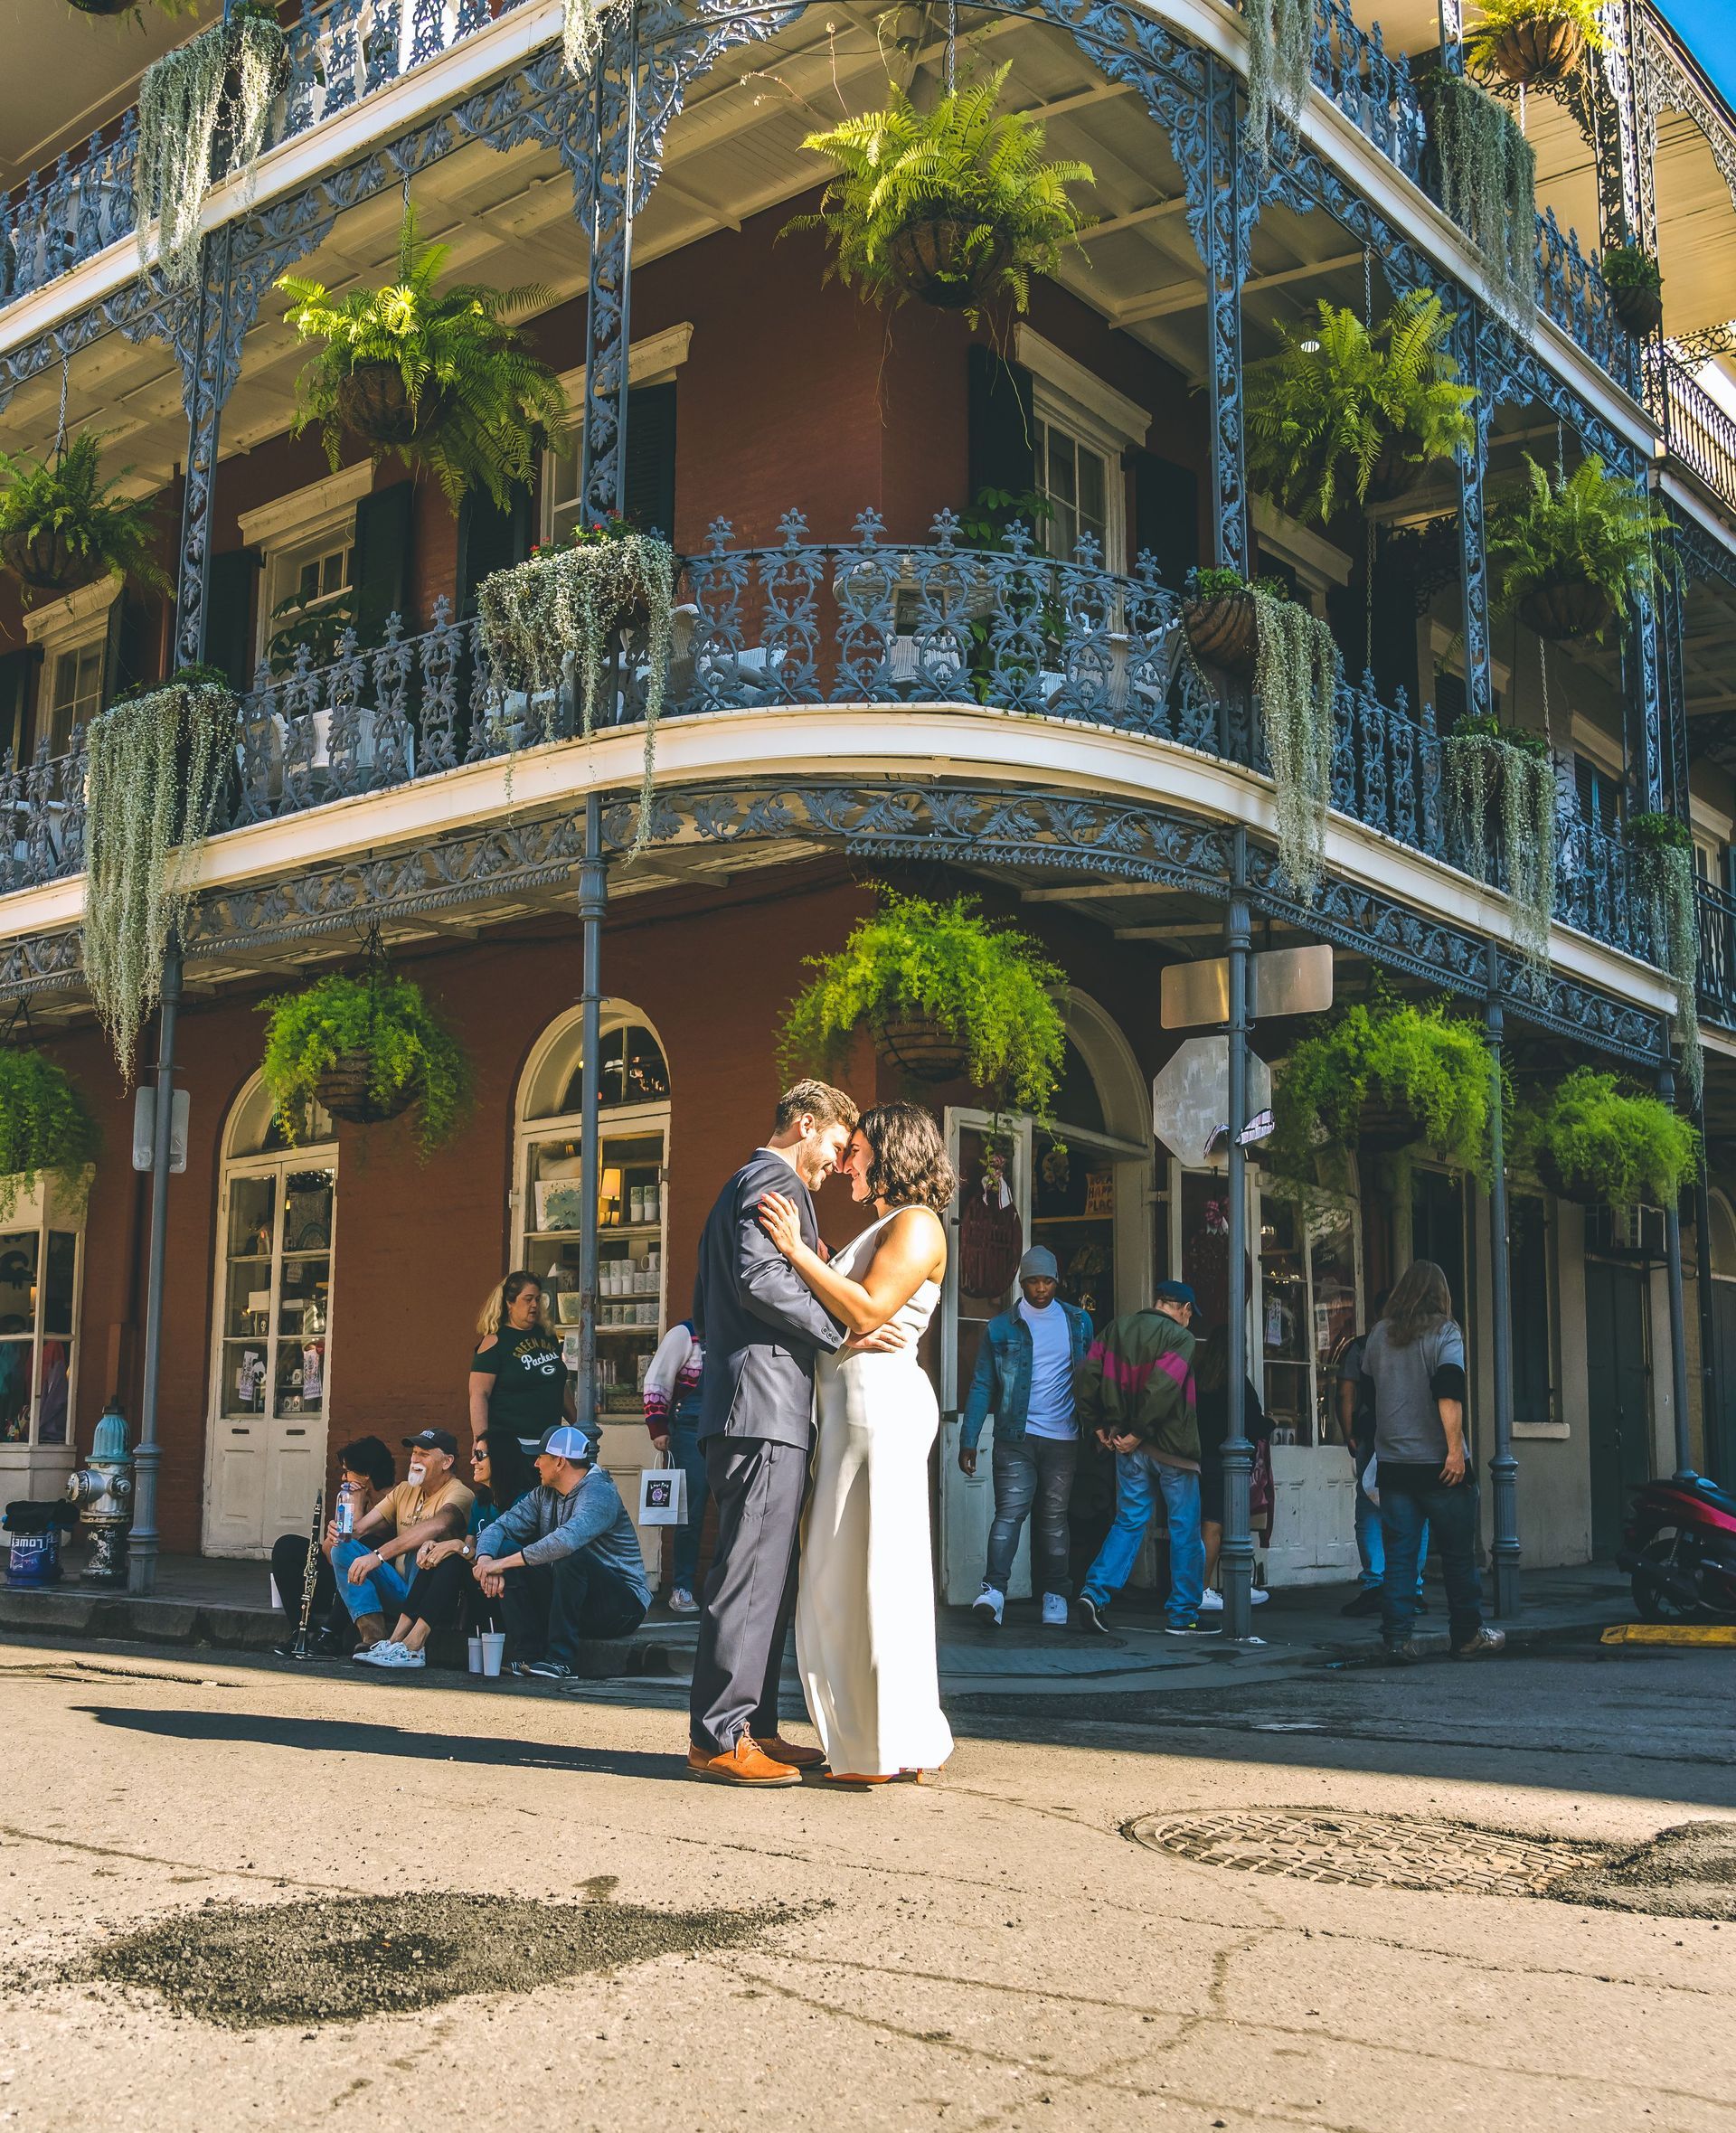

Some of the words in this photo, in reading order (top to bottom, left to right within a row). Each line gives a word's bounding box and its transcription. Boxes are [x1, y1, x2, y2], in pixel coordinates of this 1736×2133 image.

[513, 1337, 540, 1358] GREEN
[521, 1352, 560, 1371] Packers
[542, 1365, 555, 1374] G
